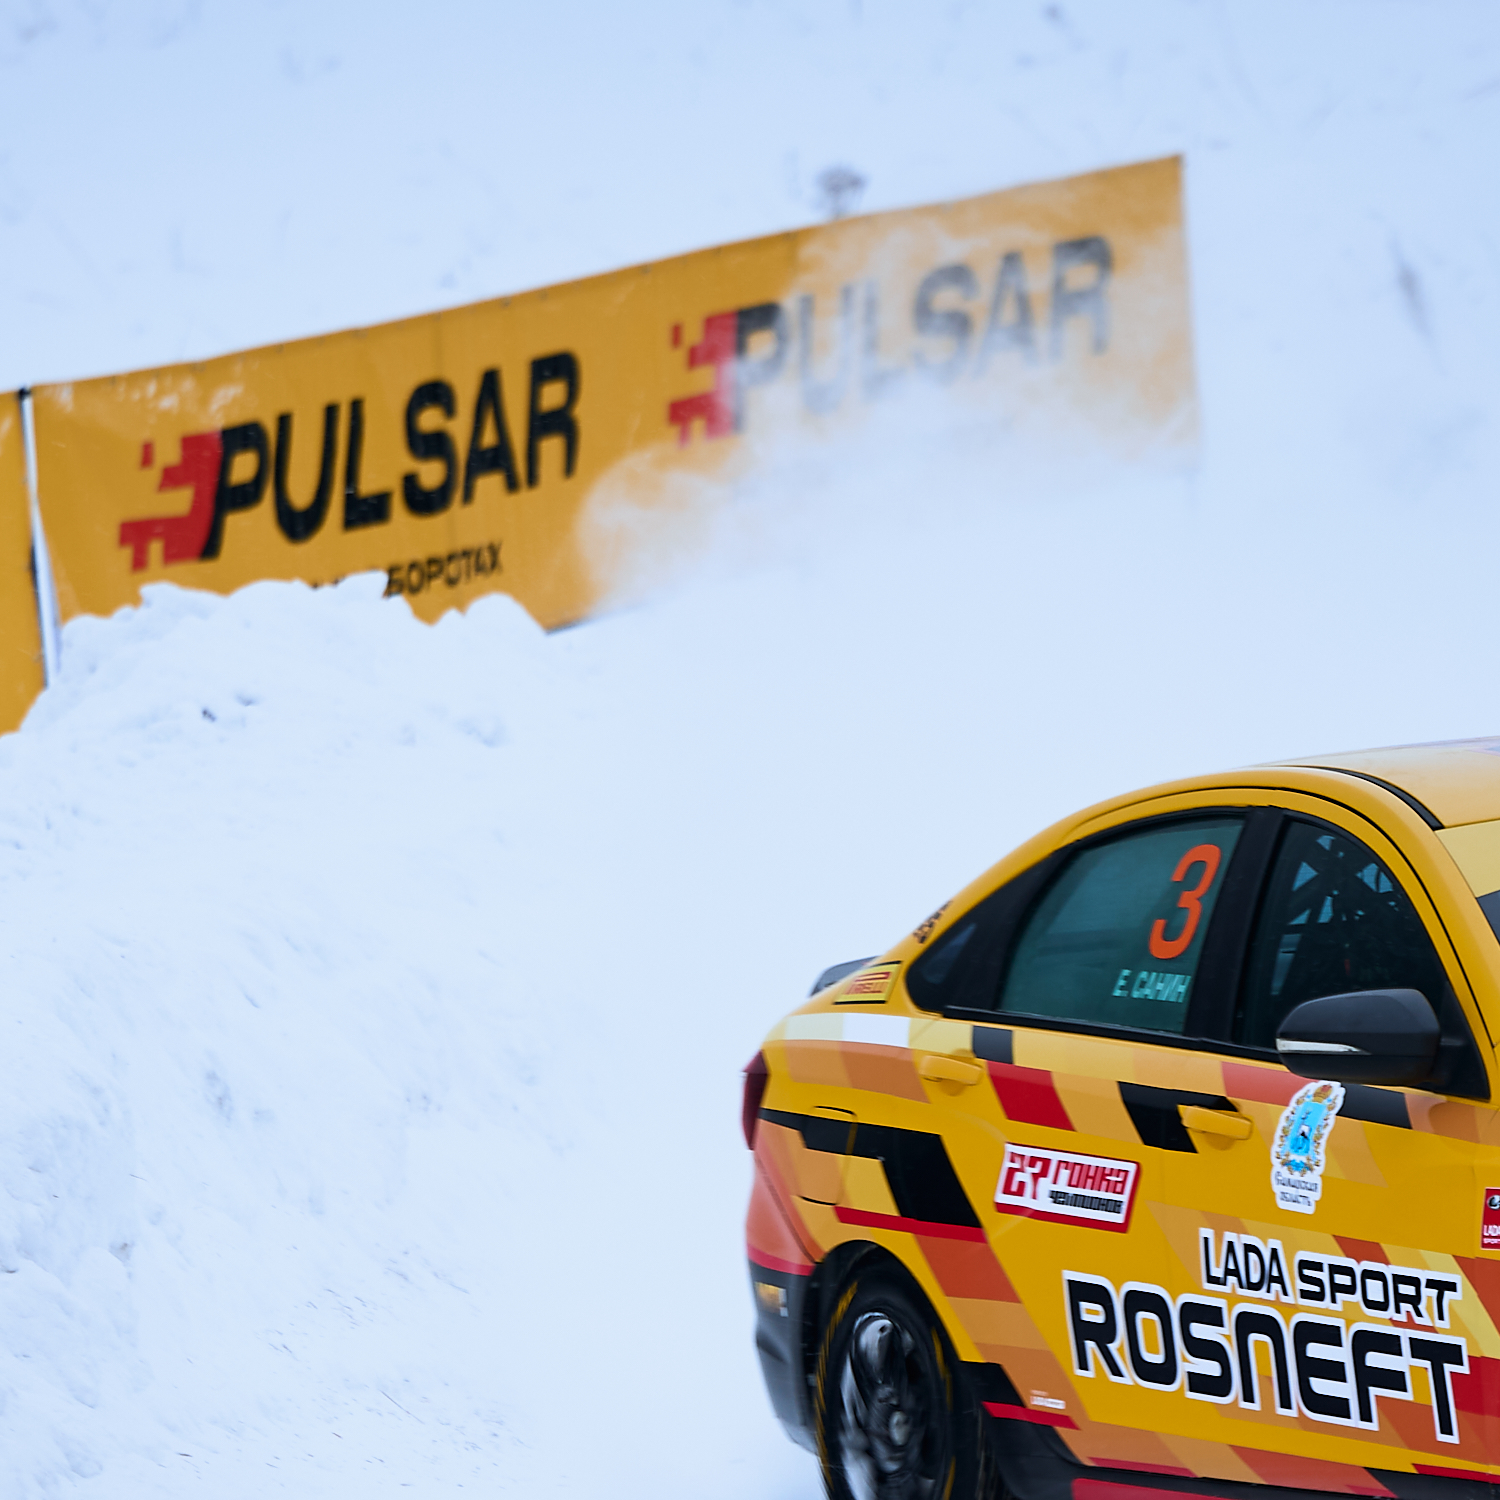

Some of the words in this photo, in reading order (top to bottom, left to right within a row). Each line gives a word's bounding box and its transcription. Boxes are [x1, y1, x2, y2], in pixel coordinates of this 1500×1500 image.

[733, 235, 1114, 435] PULSAR
[200, 349, 581, 562] PULSAR
[382, 540, 503, 598] БОРОТАХ
[1148, 843, 1222, 959] 3
[1201, 1231, 1293, 1300] LADA
[1296, 1255, 1461, 1325] SPORT
[1065, 1274, 1468, 1440] ROSNEFT
